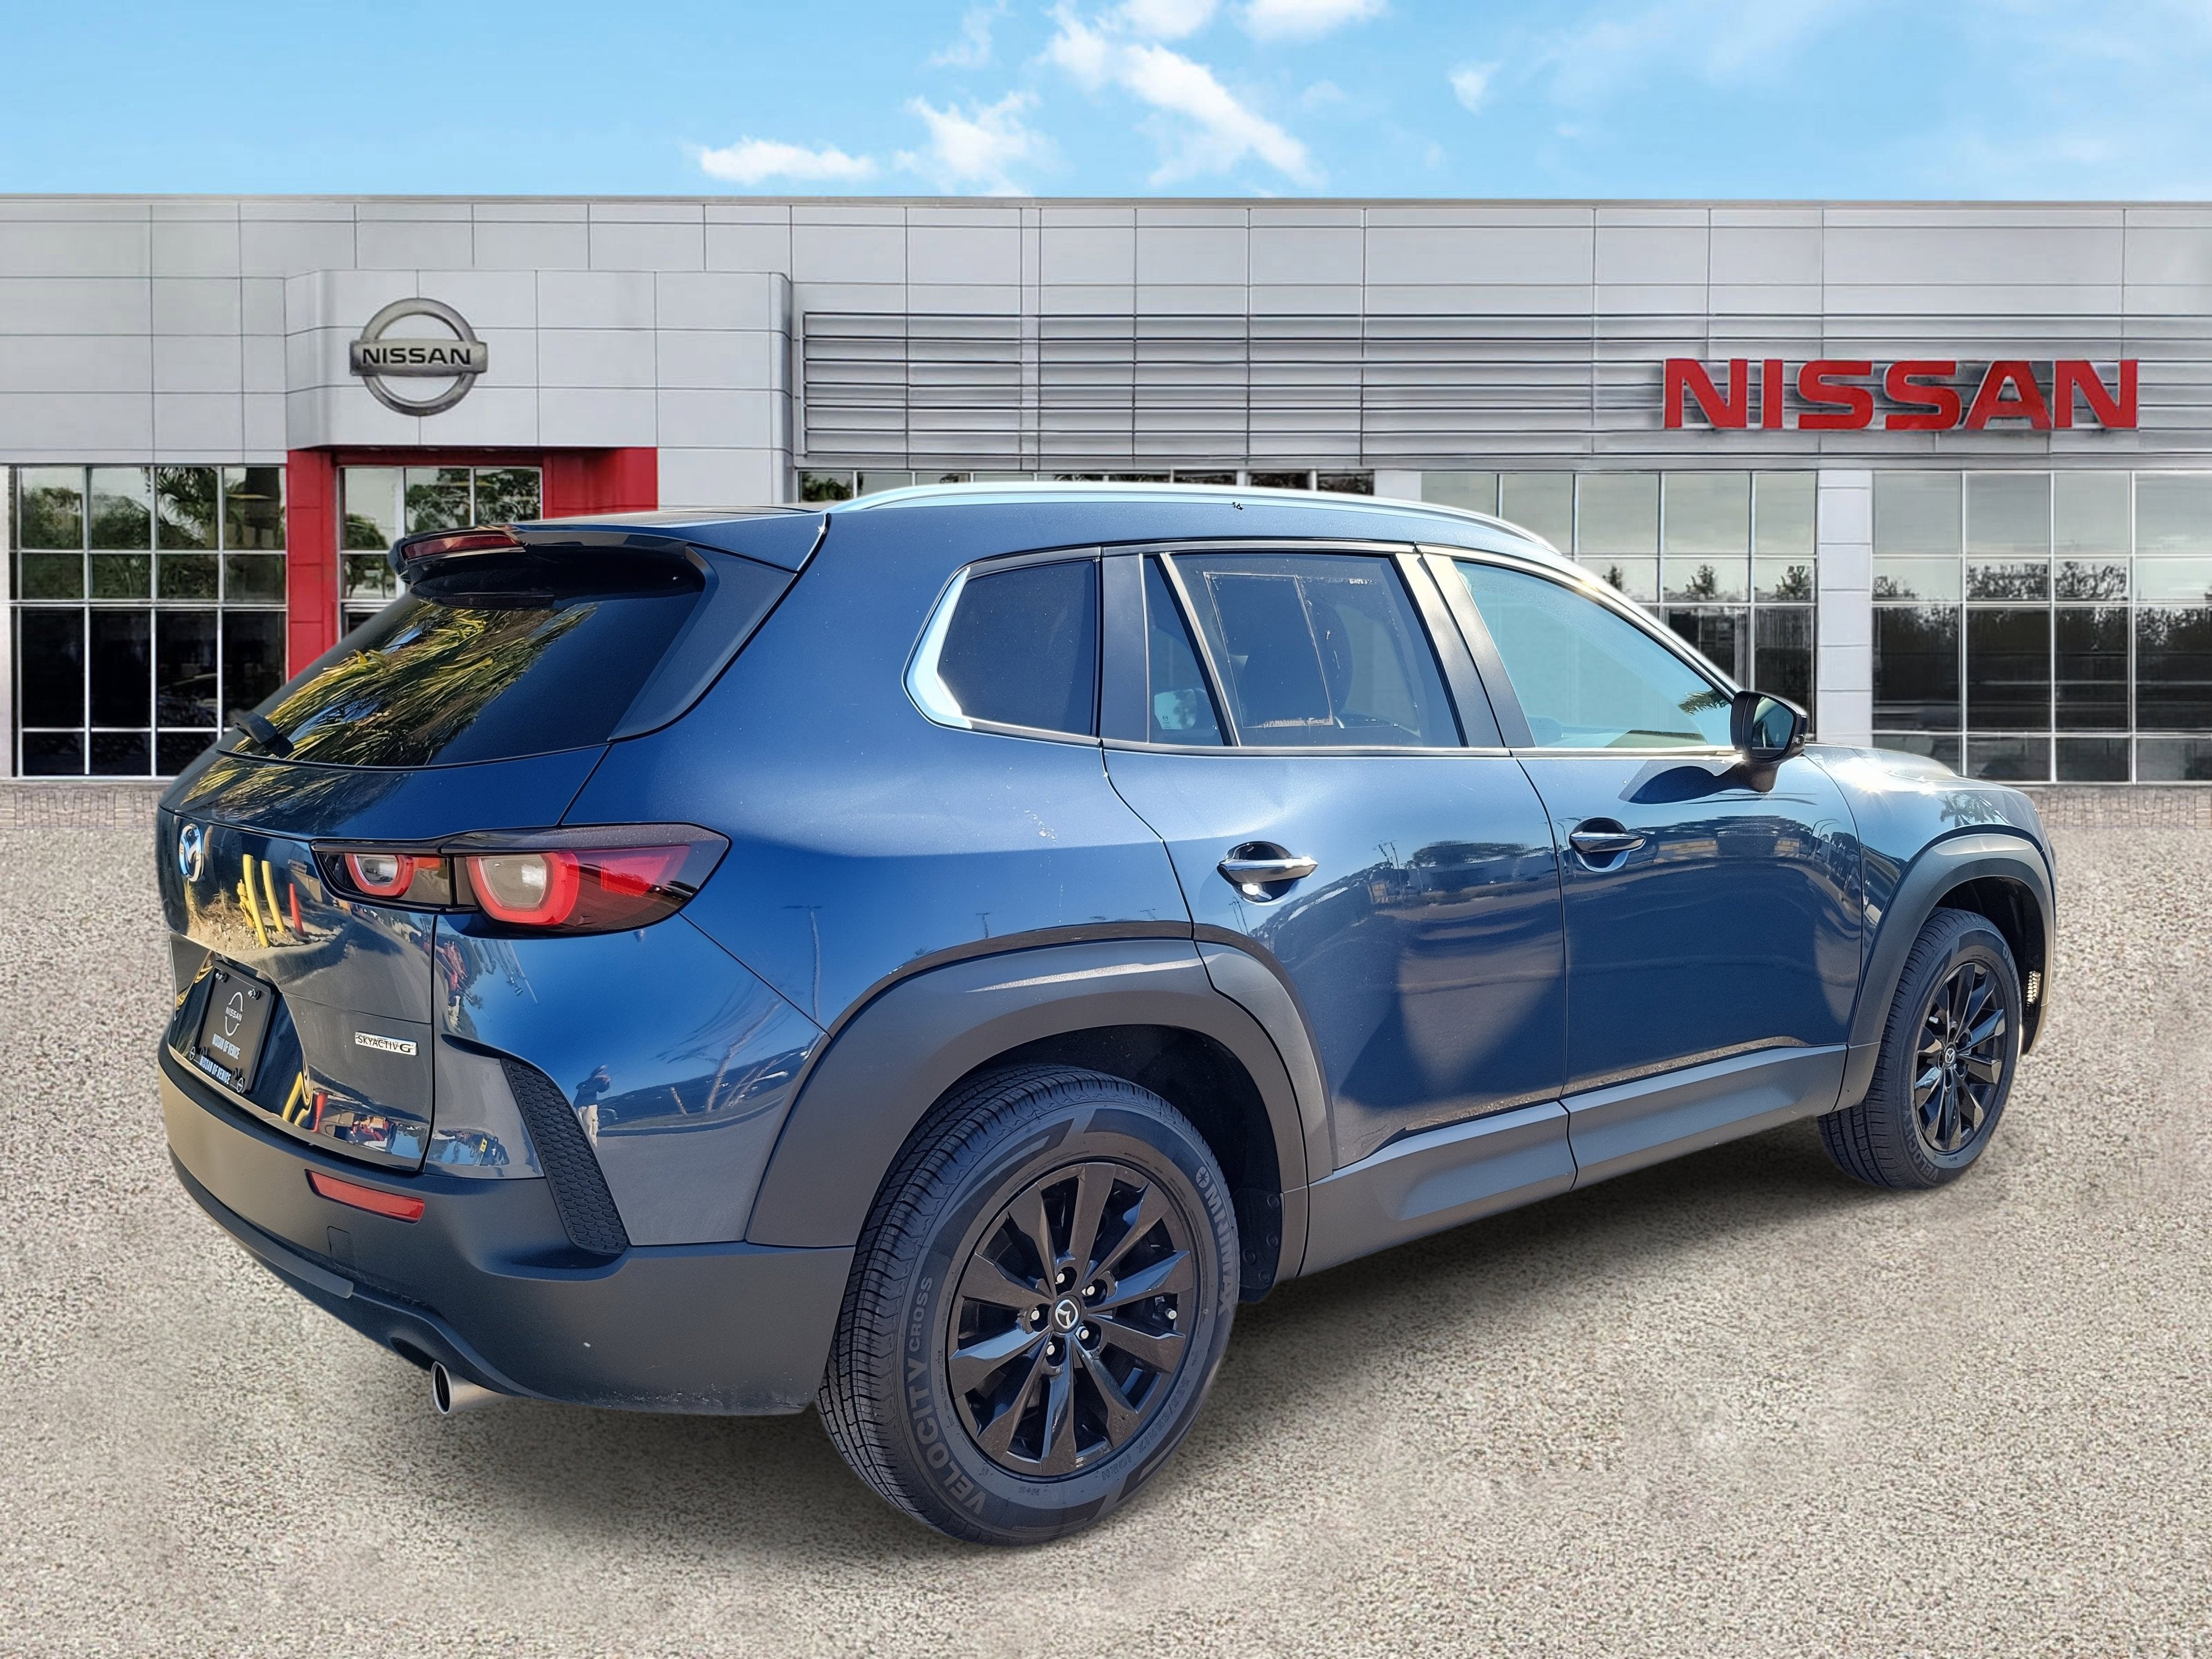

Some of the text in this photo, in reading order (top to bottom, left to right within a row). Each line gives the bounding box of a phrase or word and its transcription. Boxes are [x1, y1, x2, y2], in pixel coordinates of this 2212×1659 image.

[363, 348, 471, 365] NISSAN
[1663, 358, 2138, 431] NISSAN
[226, 1006, 243, 1022] NISSAN
[199, 1055, 231, 1084] NISSAN OF VENICE
[909, 1277, 932, 1352] CROSS
[908, 1357, 986, 1515] VELOCITY
